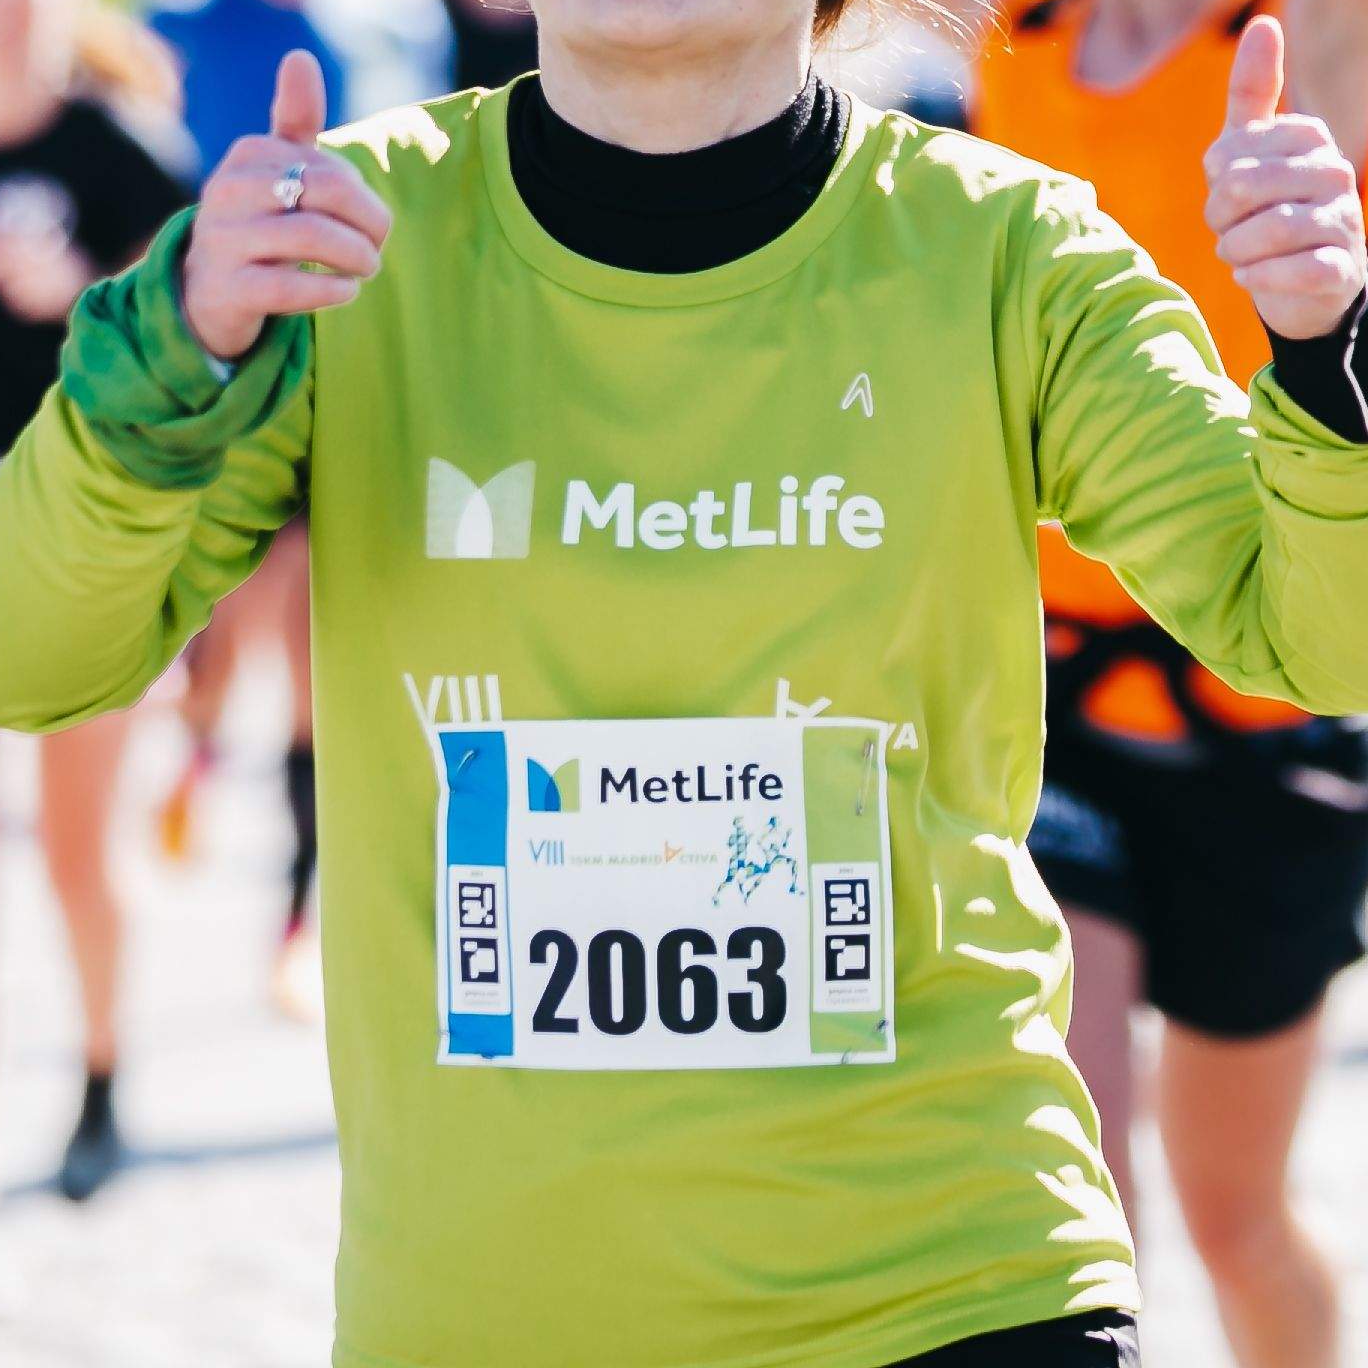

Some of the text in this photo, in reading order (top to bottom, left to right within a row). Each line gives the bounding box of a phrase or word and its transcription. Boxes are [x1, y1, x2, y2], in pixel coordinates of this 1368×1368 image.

[561, 474, 886, 550] MetLife
[600, 763, 784, 805] MetLife
[528, 839, 565, 866] VIII
[608, 853, 663, 865] MADRID
[529, 926, 788, 1036] 2063
